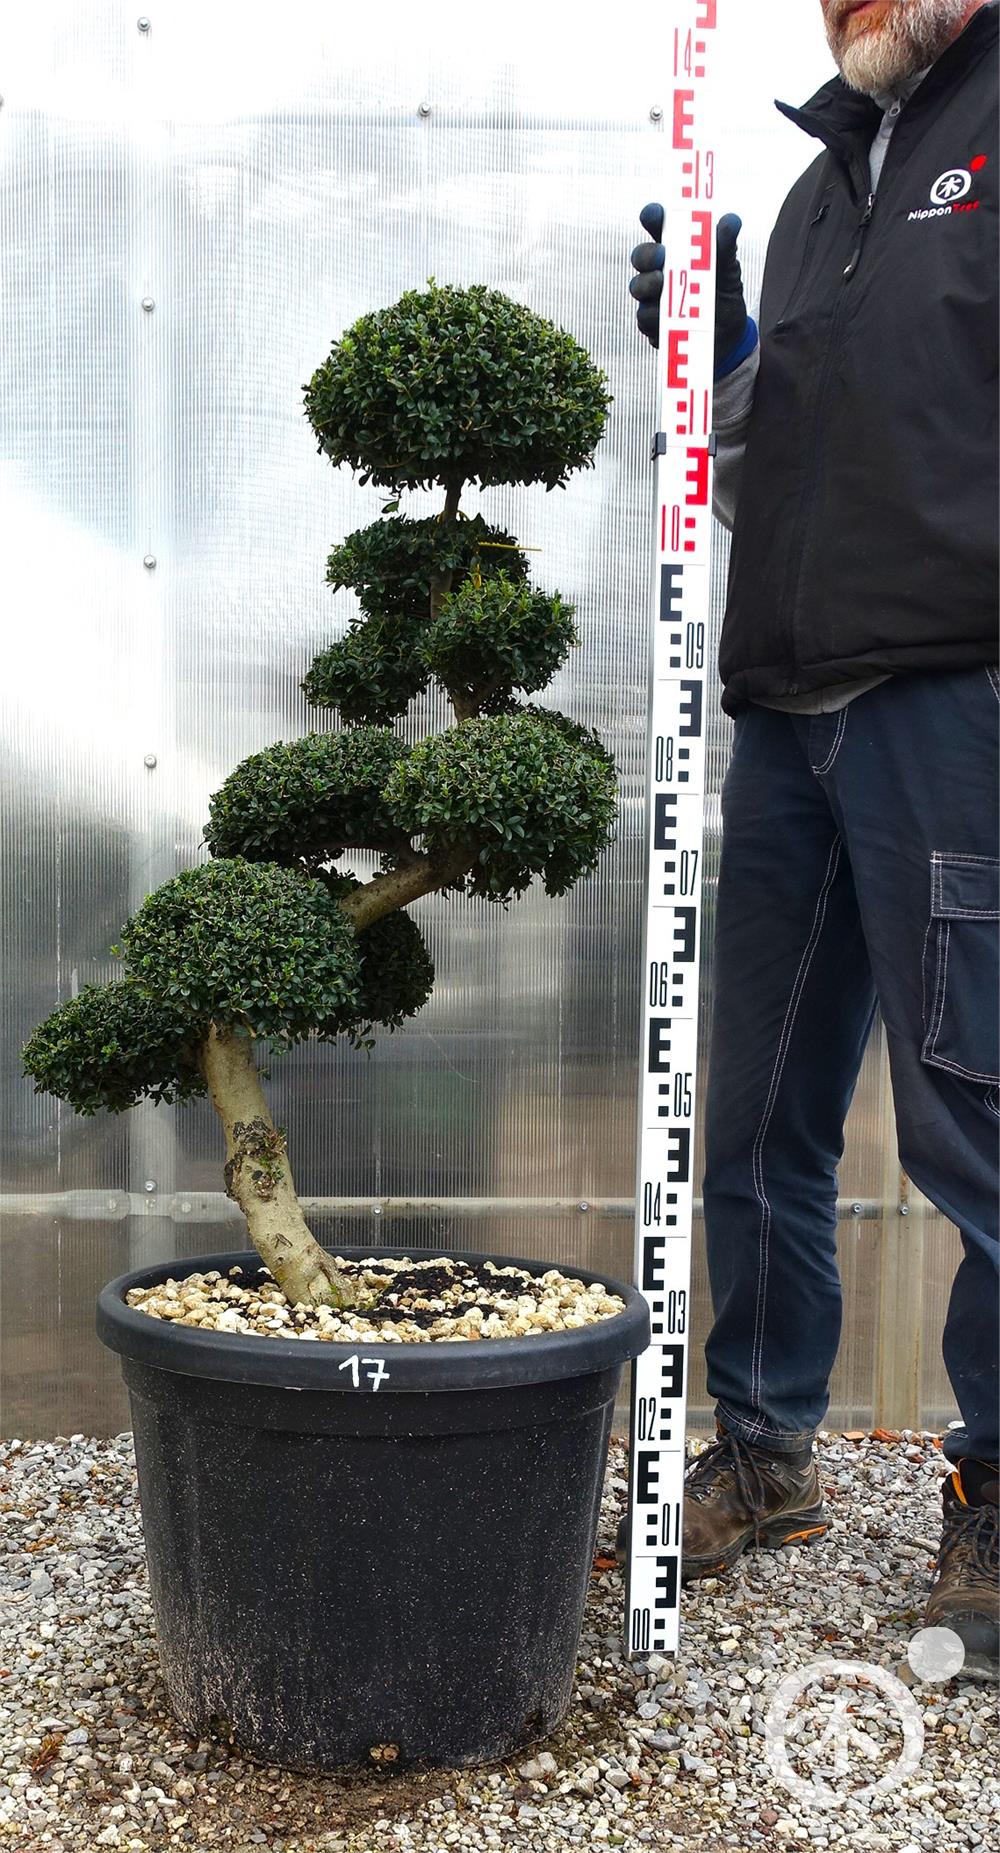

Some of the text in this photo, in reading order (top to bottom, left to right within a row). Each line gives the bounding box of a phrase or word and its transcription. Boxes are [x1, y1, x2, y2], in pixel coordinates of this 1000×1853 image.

[673, 27, 692, 77] 14
[695, 150, 714, 199] 13
[907, 200, 980, 221] NipponTree
[668, 269, 687, 318] 12
[689, 389, 708, 435] 11
[661, 504, 680, 551] 10
[686, 622, 704, 669] 09
[655, 736, 674, 782] 08
[680, 850, 698, 896] 07
[649, 961, 668, 1007] 06
[674, 1072, 692, 1117] 05
[643, 1181, 661, 1226] 04
[667, 1290, 686, 1334] 03
[338, 1354, 391, 1392] 17
[637, 1397, 656, 1441] 02
[661, 1503, 680, 1546] 01
[632, 1608, 650, 1650] 00
